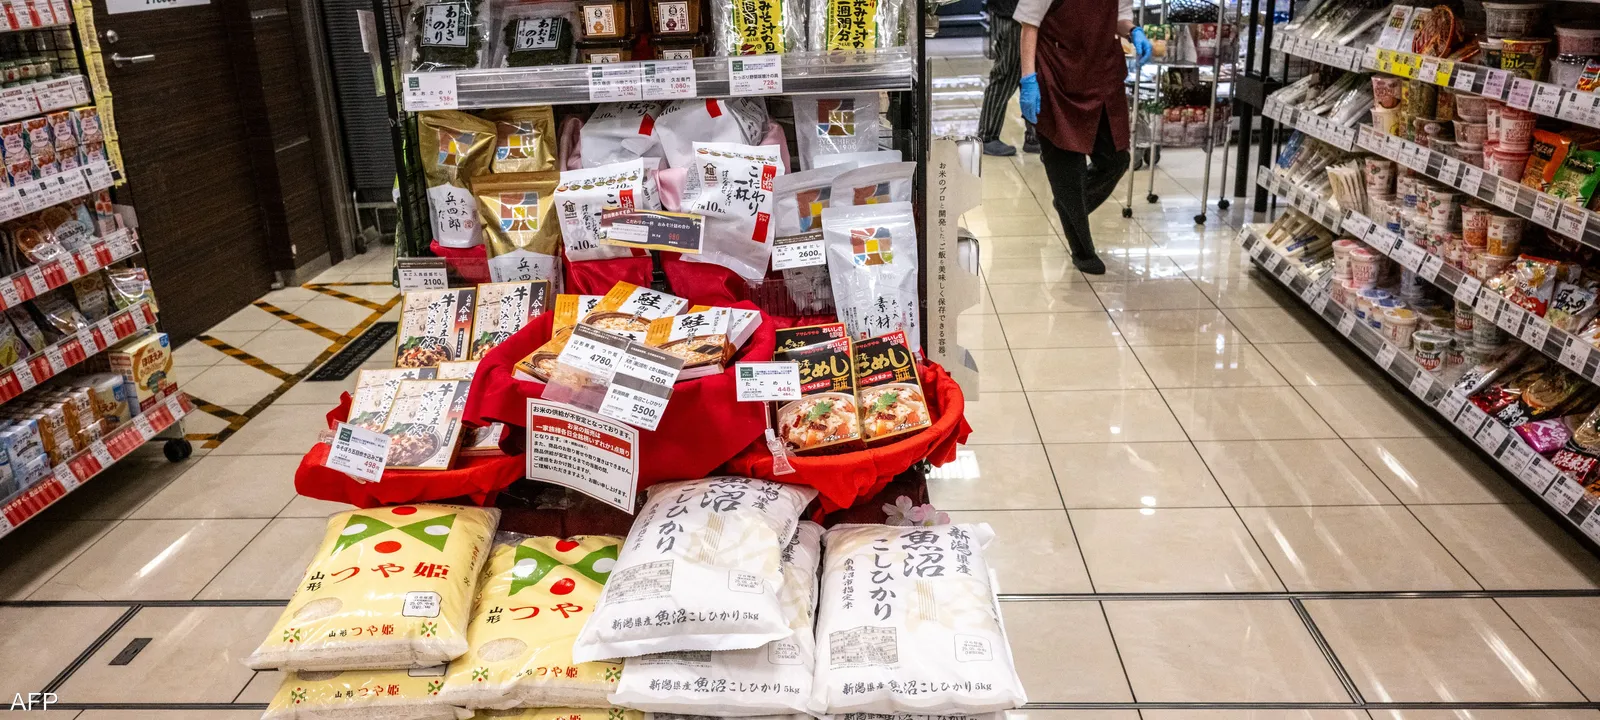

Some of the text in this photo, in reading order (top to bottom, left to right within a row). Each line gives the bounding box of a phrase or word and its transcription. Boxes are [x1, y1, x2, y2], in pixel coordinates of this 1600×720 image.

[445, 192, 461, 232] 兵四郎
[632, 292, 662, 310] 鮭
[678, 314, 710, 331] 鮭
[532, 405, 632, 441] お米の供給が不安定となっております。
[899, 530, 945, 578] 魚沼
[306, 570, 325, 593] 山形
[330, 560, 451, 585] つや姫
[869, 537, 897, 621] こしひかり
[486, 605, 503, 625] 山形
[509, 602, 597, 622] つや
[350, 622, 396, 638] つや姫
[536, 664, 579, 679] つや姫
[357, 683, 401, 698] つや姫
